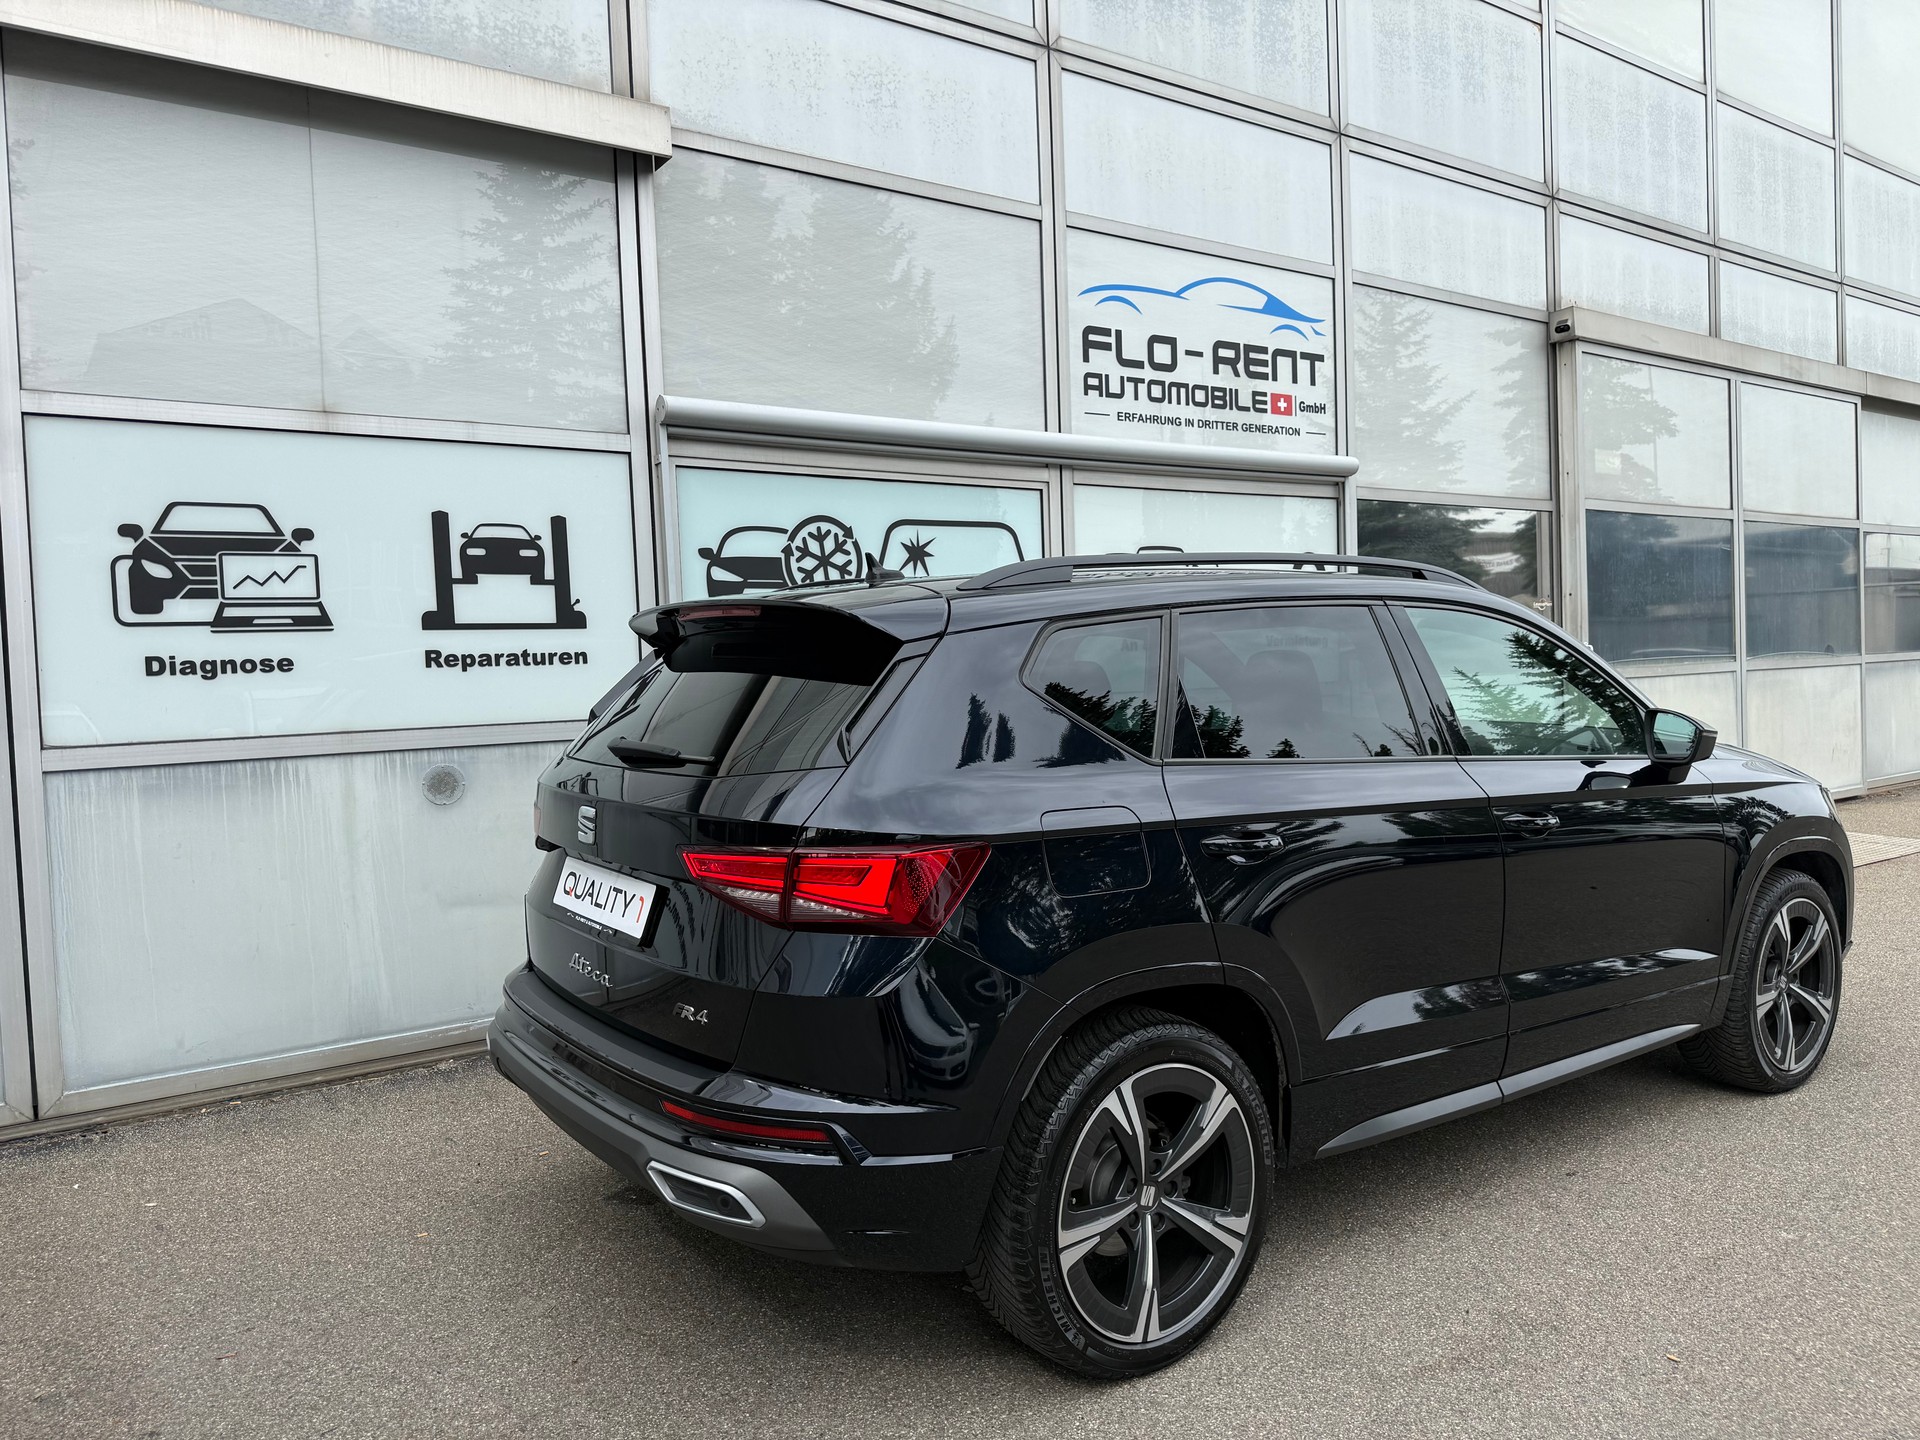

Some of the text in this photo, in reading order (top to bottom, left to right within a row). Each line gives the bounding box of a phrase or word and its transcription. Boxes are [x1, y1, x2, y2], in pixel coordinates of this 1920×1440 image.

[1082, 325, 1325, 386] FLO-RENT
[1083, 372, 1326, 415] AUTOMOBILE GmbH
[1116, 411, 1301, 437] ERFAHRUNG IN DRITTER GENERATION
[144, 654, 295, 680] Diagnose
[424, 648, 589, 672] Reparaturen
[568, 952, 613, 987] Ateca
[1245, 1085, 1271, 1159] MICHELIN
[1039, 1252, 1072, 1333] MICHELIN
